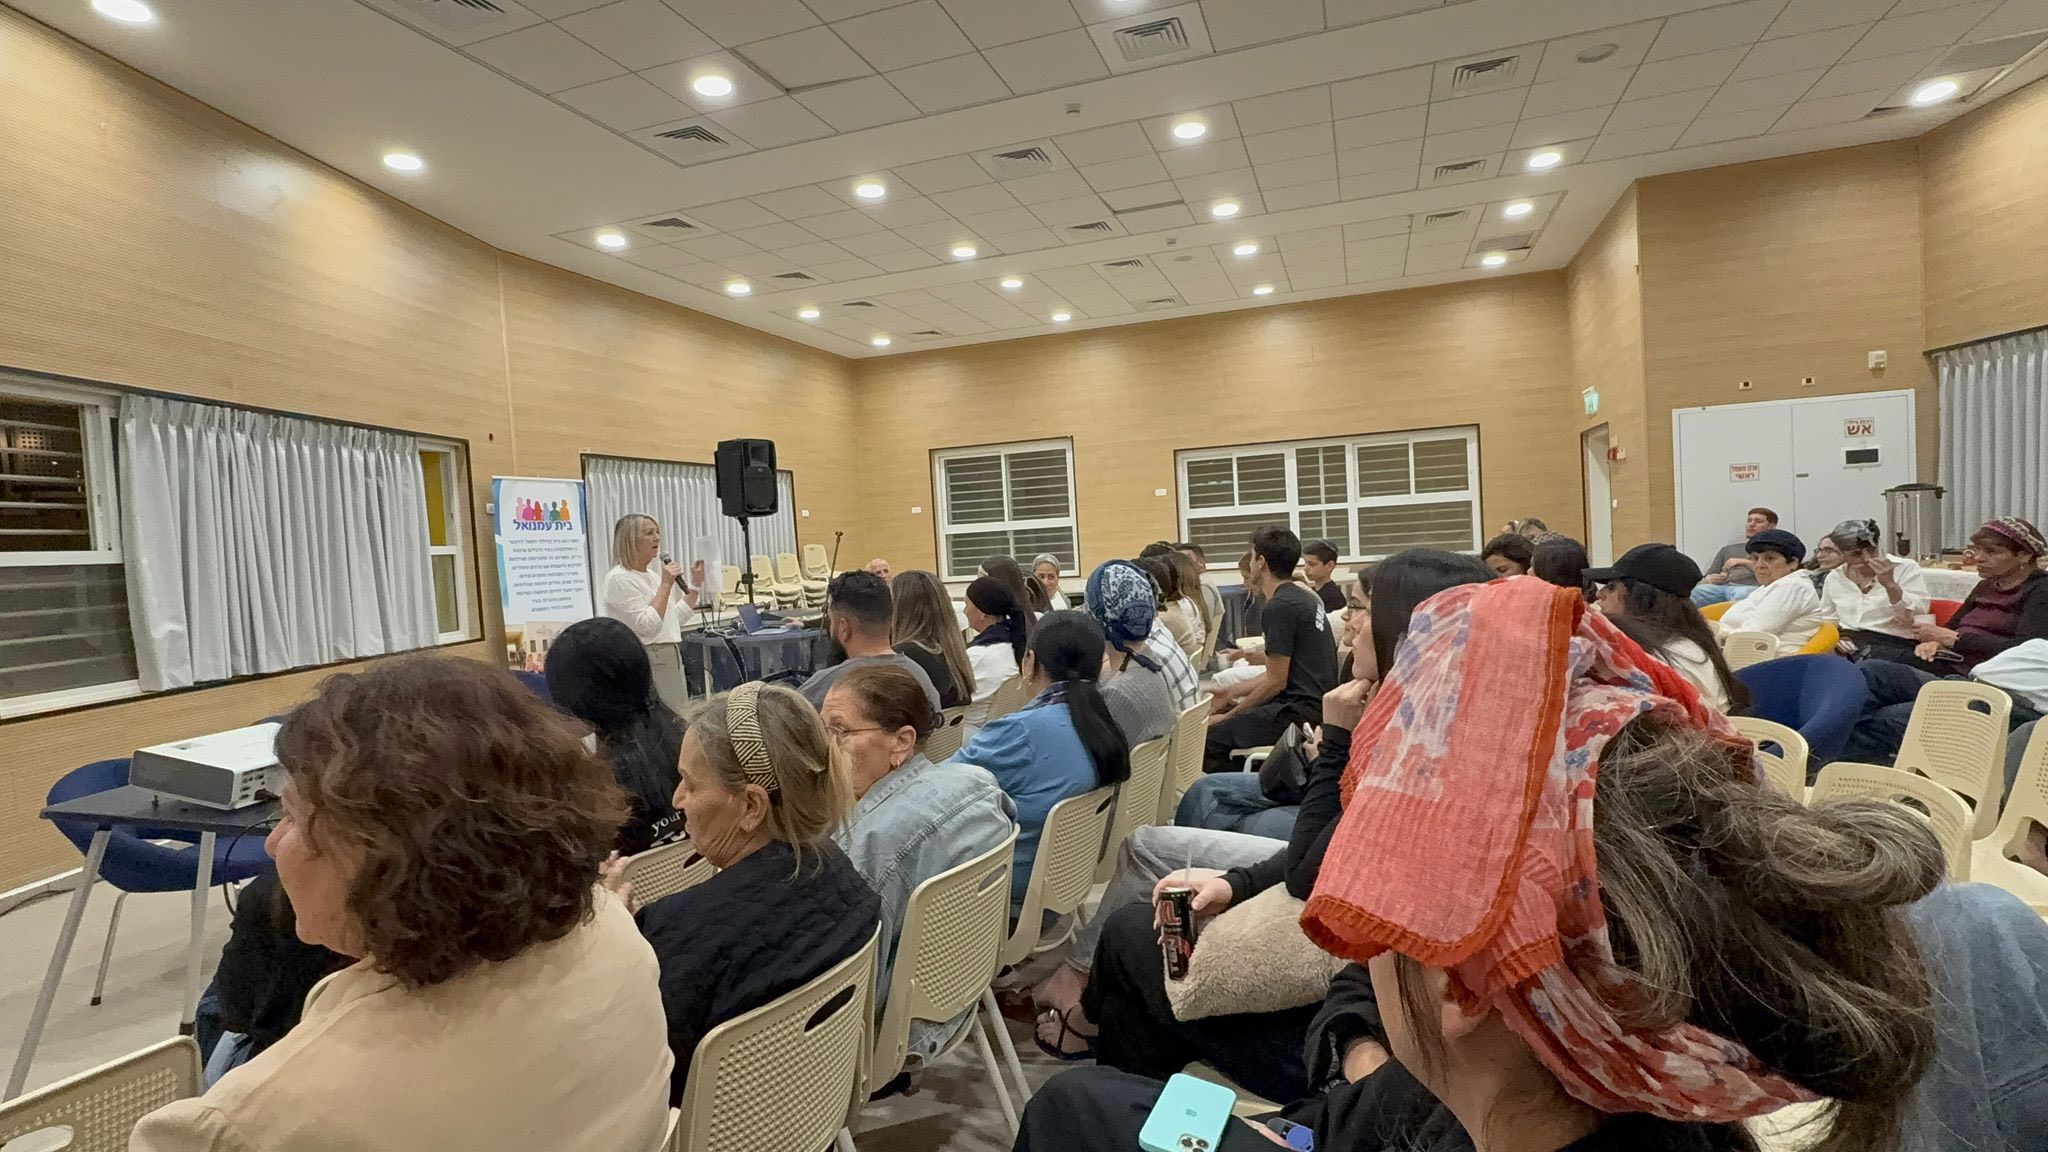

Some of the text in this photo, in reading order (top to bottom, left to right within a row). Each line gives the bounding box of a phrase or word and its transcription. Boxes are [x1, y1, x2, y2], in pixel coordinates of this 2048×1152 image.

[1847, 424, 1872, 436] אש
[1735, 472, 1755, 480] ראשי
[512, 519, 573, 531] בית עמנואל
[651, 811, 681, 838] your
